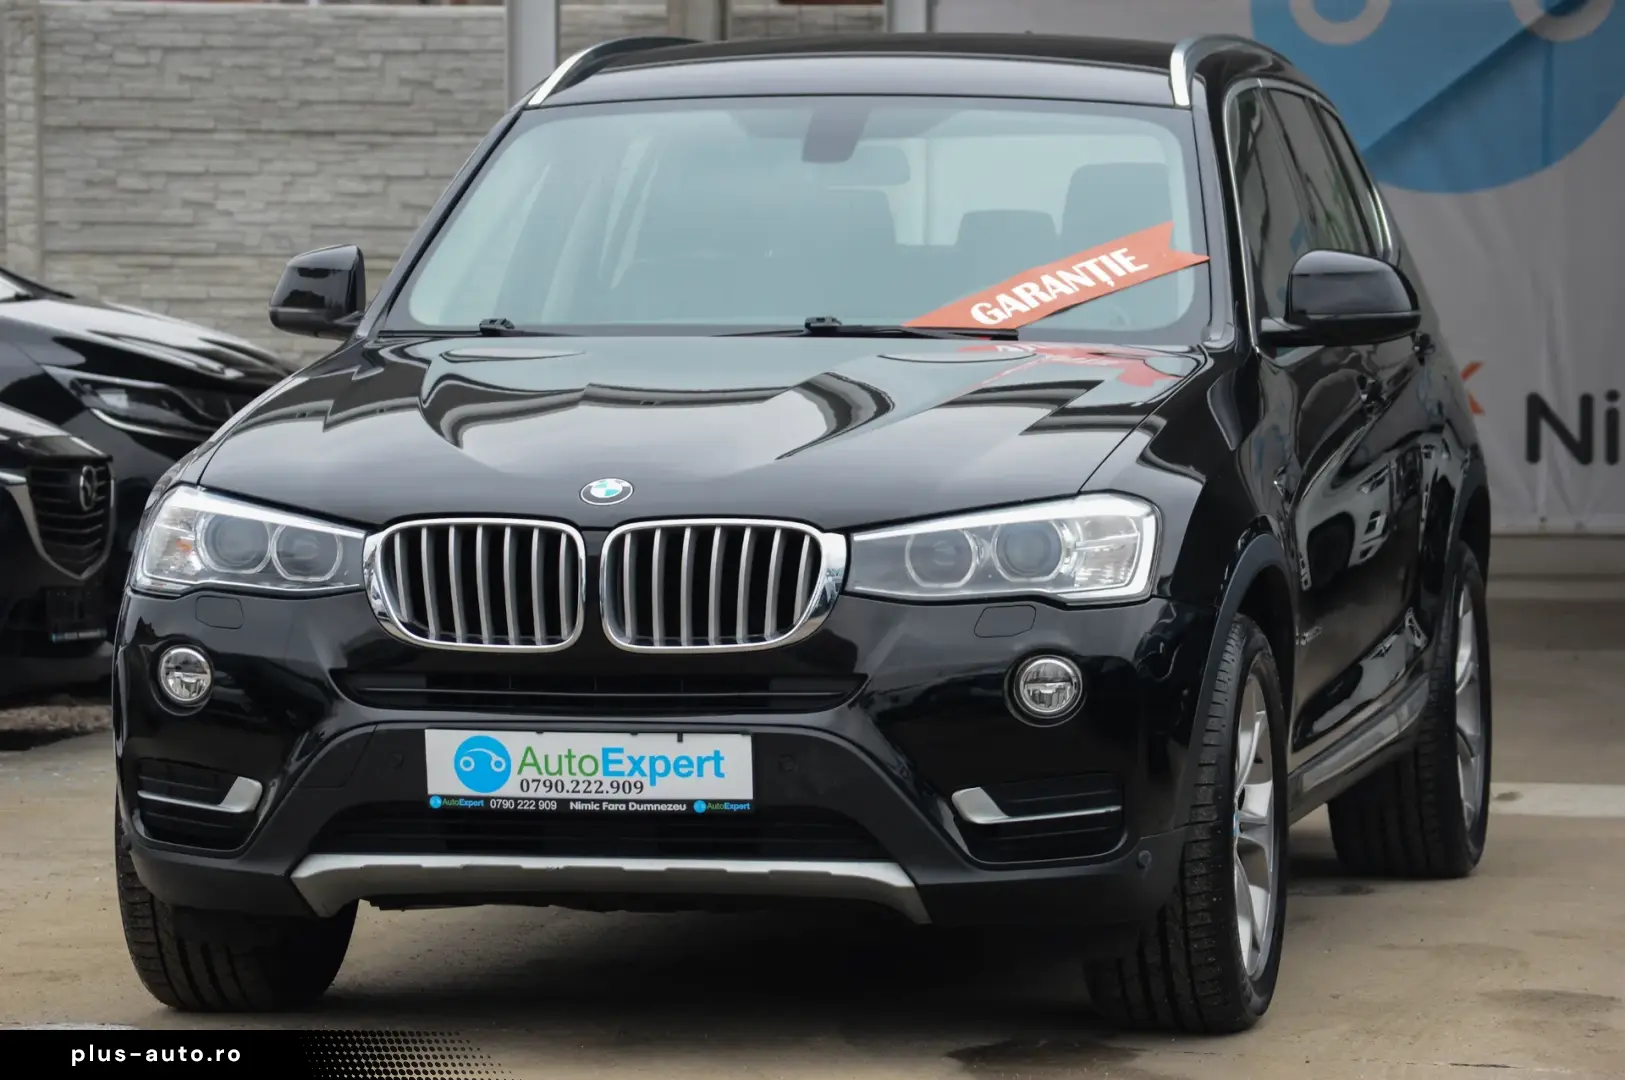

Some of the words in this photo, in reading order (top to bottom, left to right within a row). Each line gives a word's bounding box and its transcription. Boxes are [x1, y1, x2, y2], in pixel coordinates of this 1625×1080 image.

[970, 247, 1149, 325] GARANȚIE
[517, 746, 725, 787] AutoExpert
[519, 779, 645, 795] 0790.222.909
[442, 798, 484, 807] AutoExpert
[489, 799, 515, 809] 0790
[517, 800, 536, 810] 222
[538, 800, 557, 810] 909
[569, 801, 600, 811] Nimic
[602, 801, 626, 811] Fara
[628, 801, 687, 811] Dumnezeu
[706, 802, 751, 811] AutoExpert
